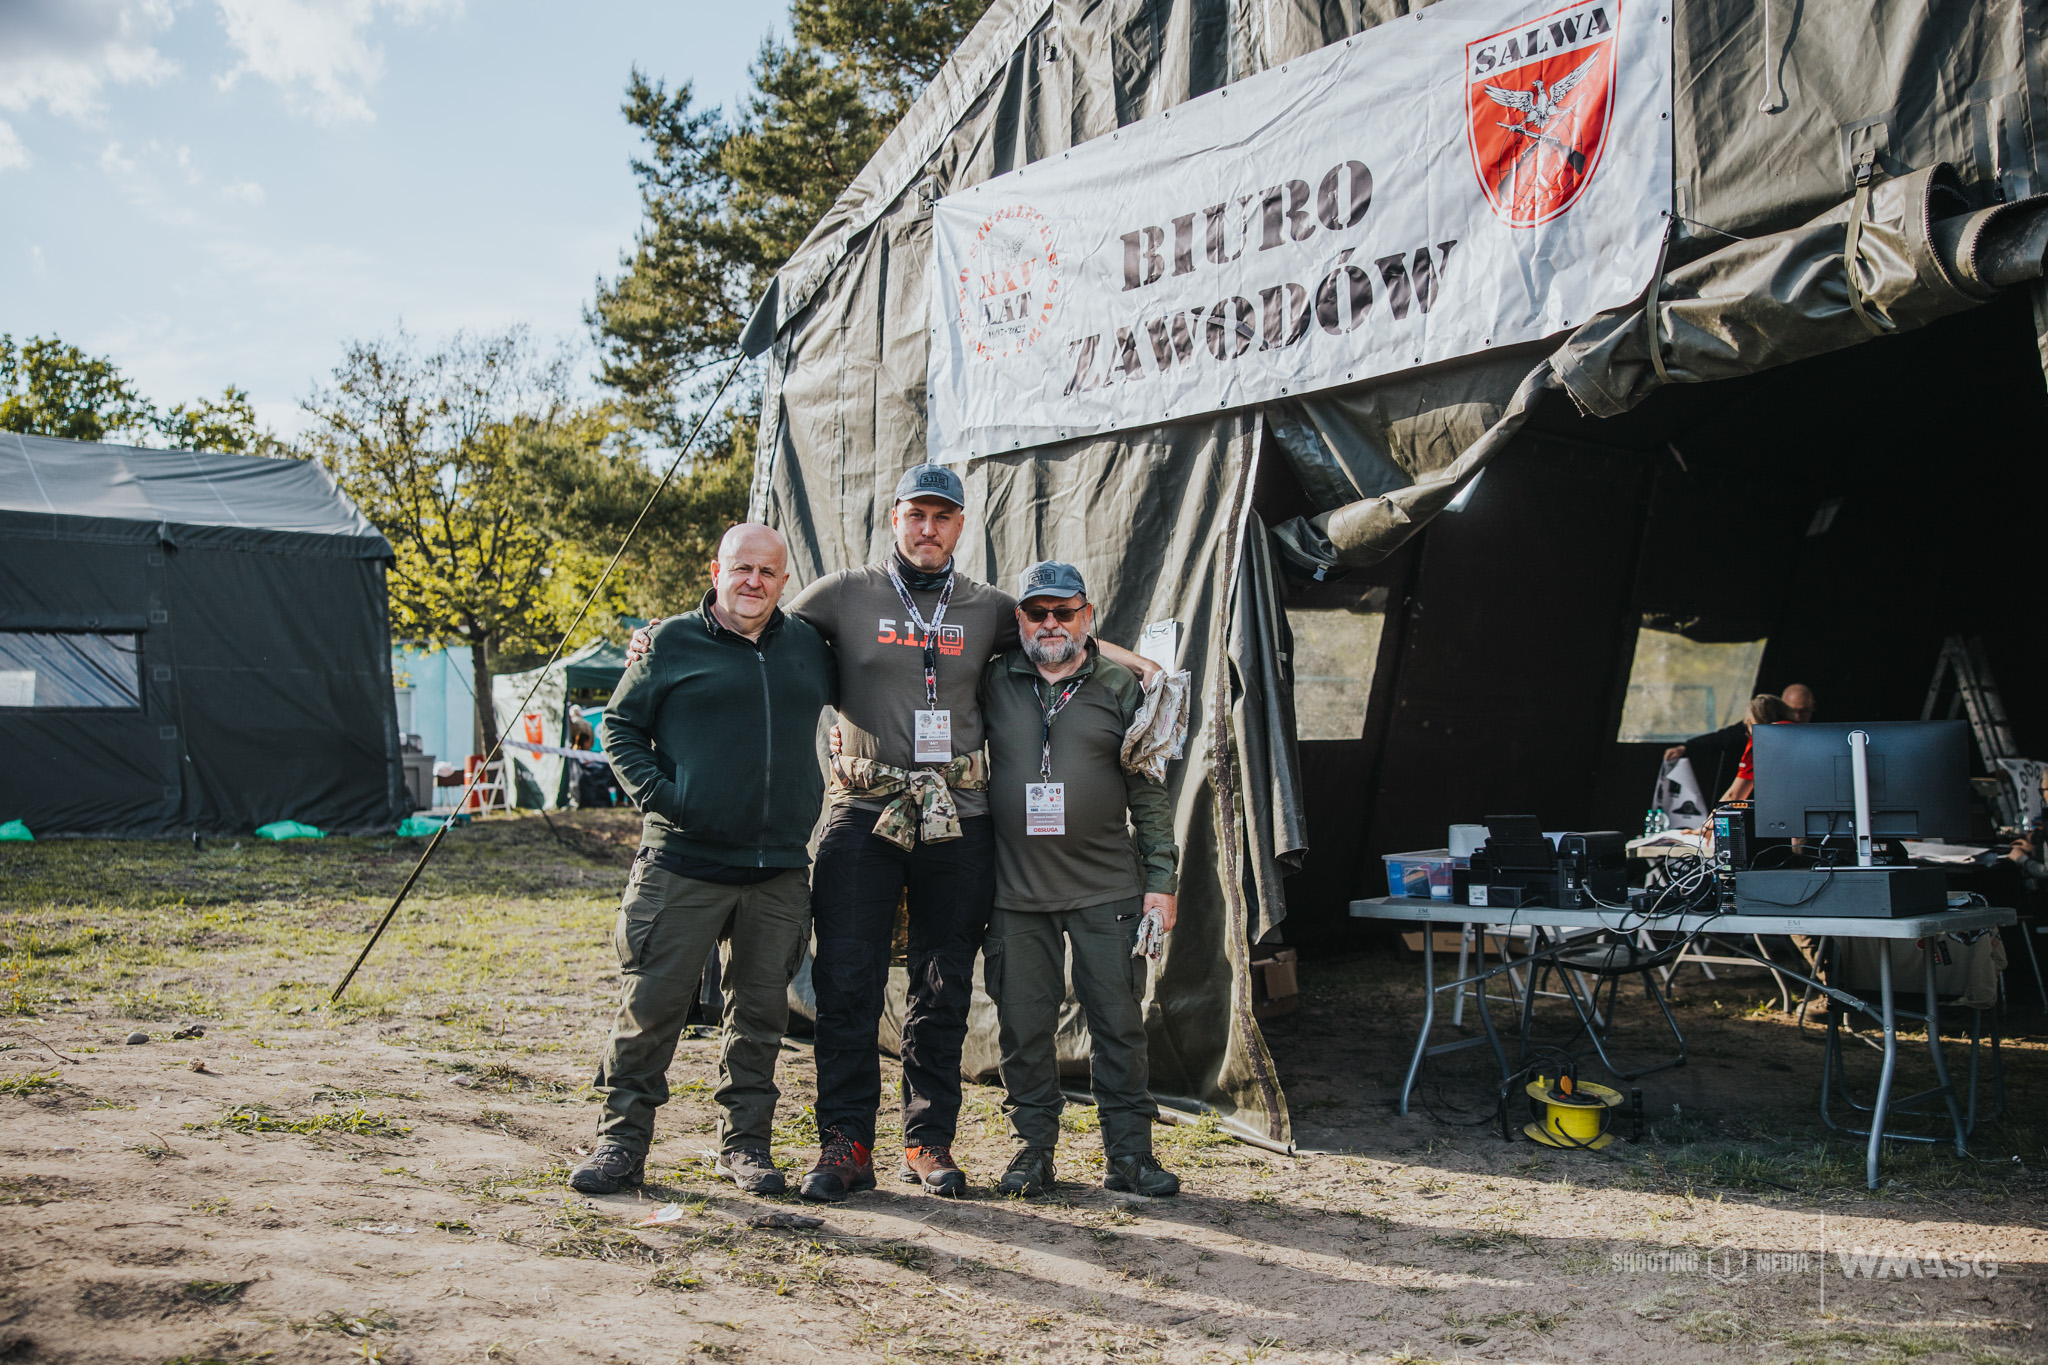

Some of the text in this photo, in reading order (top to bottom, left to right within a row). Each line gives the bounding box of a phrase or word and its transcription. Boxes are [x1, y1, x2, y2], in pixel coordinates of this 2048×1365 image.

[1475, 7, 1612, 76] SALWA
[1121, 159, 1373, 292] BIURO
[979, 257, 1038, 300] XXV
[983, 291, 1032, 328] LAT
[1064, 239, 1457, 396] ZAWODÓW
[939, 647, 962, 656] POLAND
